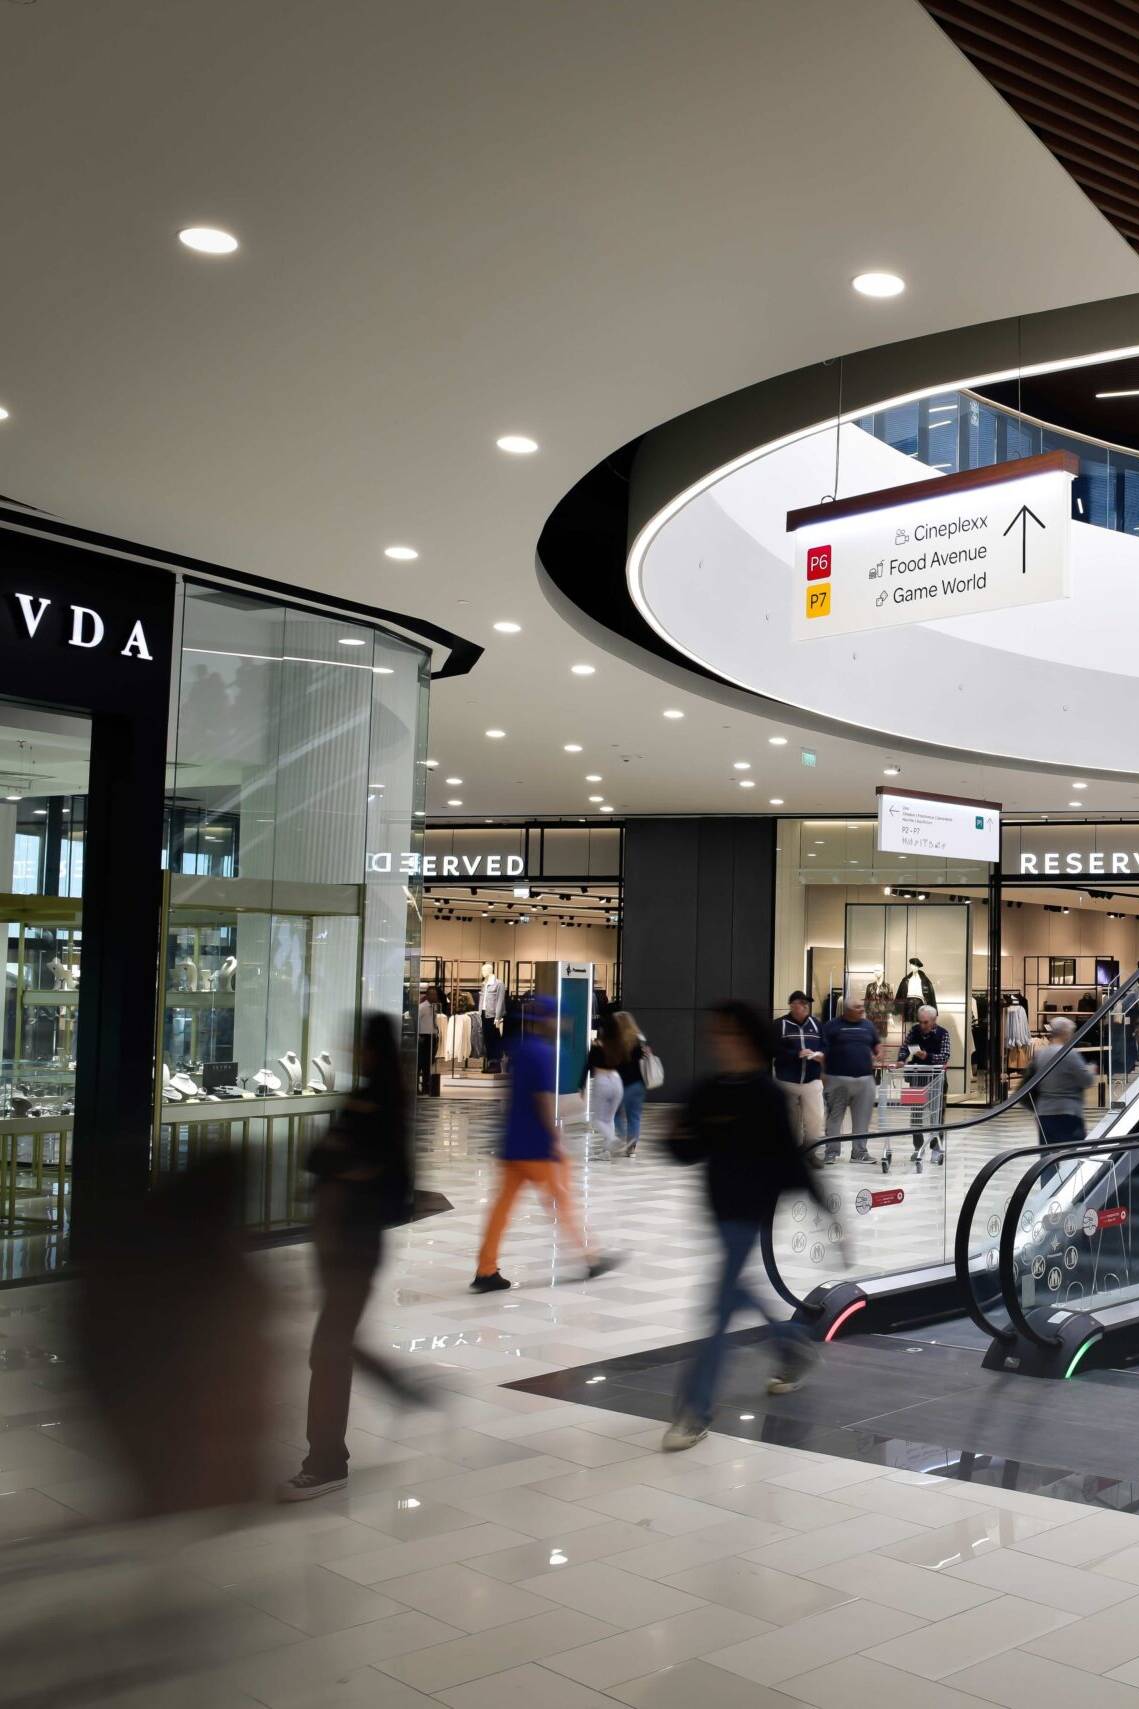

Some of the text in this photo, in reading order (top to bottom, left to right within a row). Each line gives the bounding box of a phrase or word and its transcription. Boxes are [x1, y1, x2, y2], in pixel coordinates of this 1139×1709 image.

[914, 516, 988, 542] Cineplexx
[810, 554, 828, 571] P6
[889, 546, 987, 576] Food Avenue
[810, 591, 827, 609] P7
[893, 571, 987, 604] Game World
[15, 592, 153, 661] VDA
